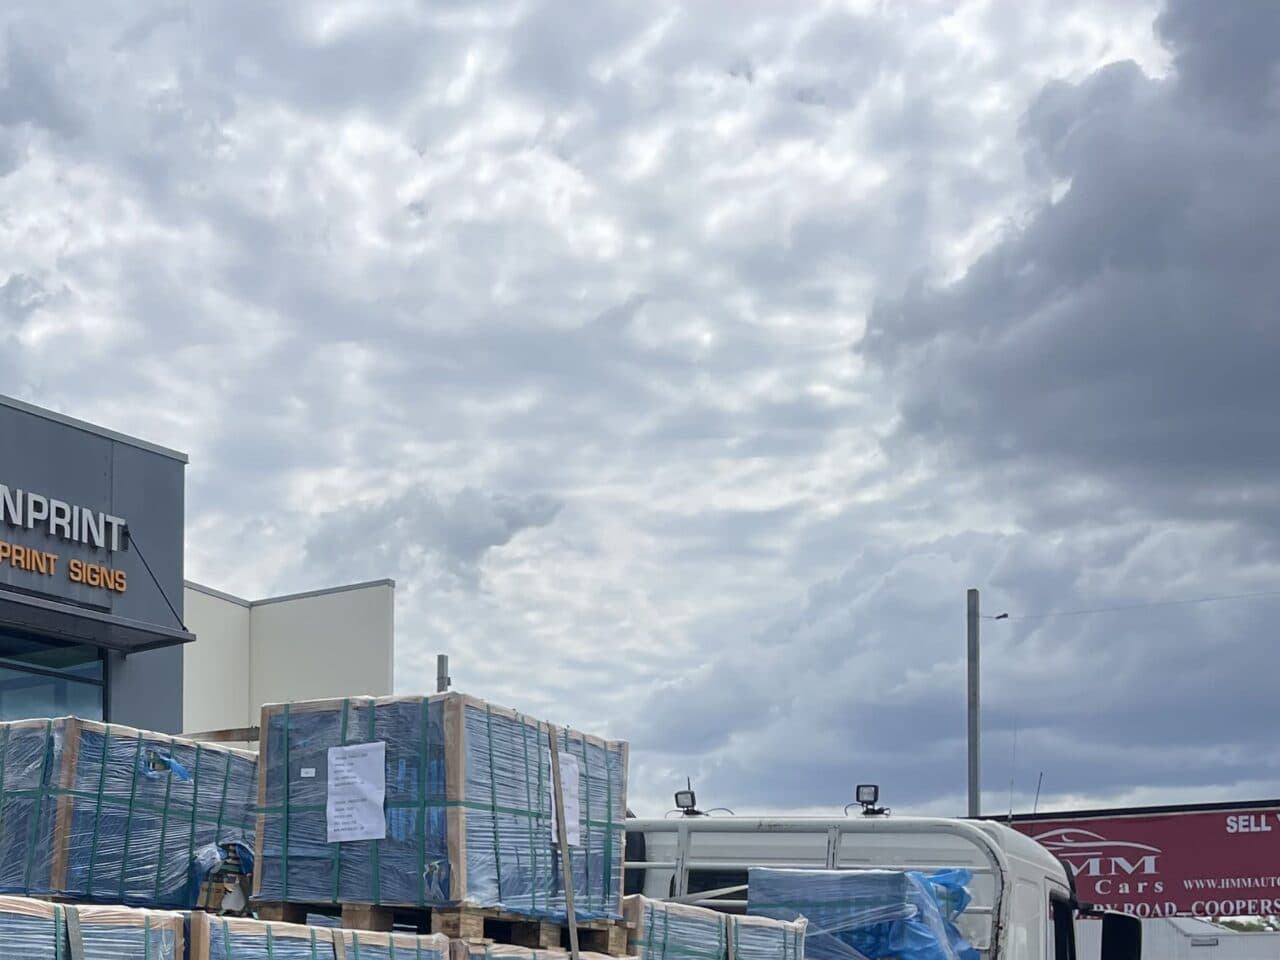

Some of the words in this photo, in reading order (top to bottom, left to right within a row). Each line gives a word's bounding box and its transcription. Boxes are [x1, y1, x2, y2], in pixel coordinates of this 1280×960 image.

[70, 559, 127, 592] SIGNS
[1226, 815, 1272, 833] SELL
[1094, 880, 1164, 895] Cars
